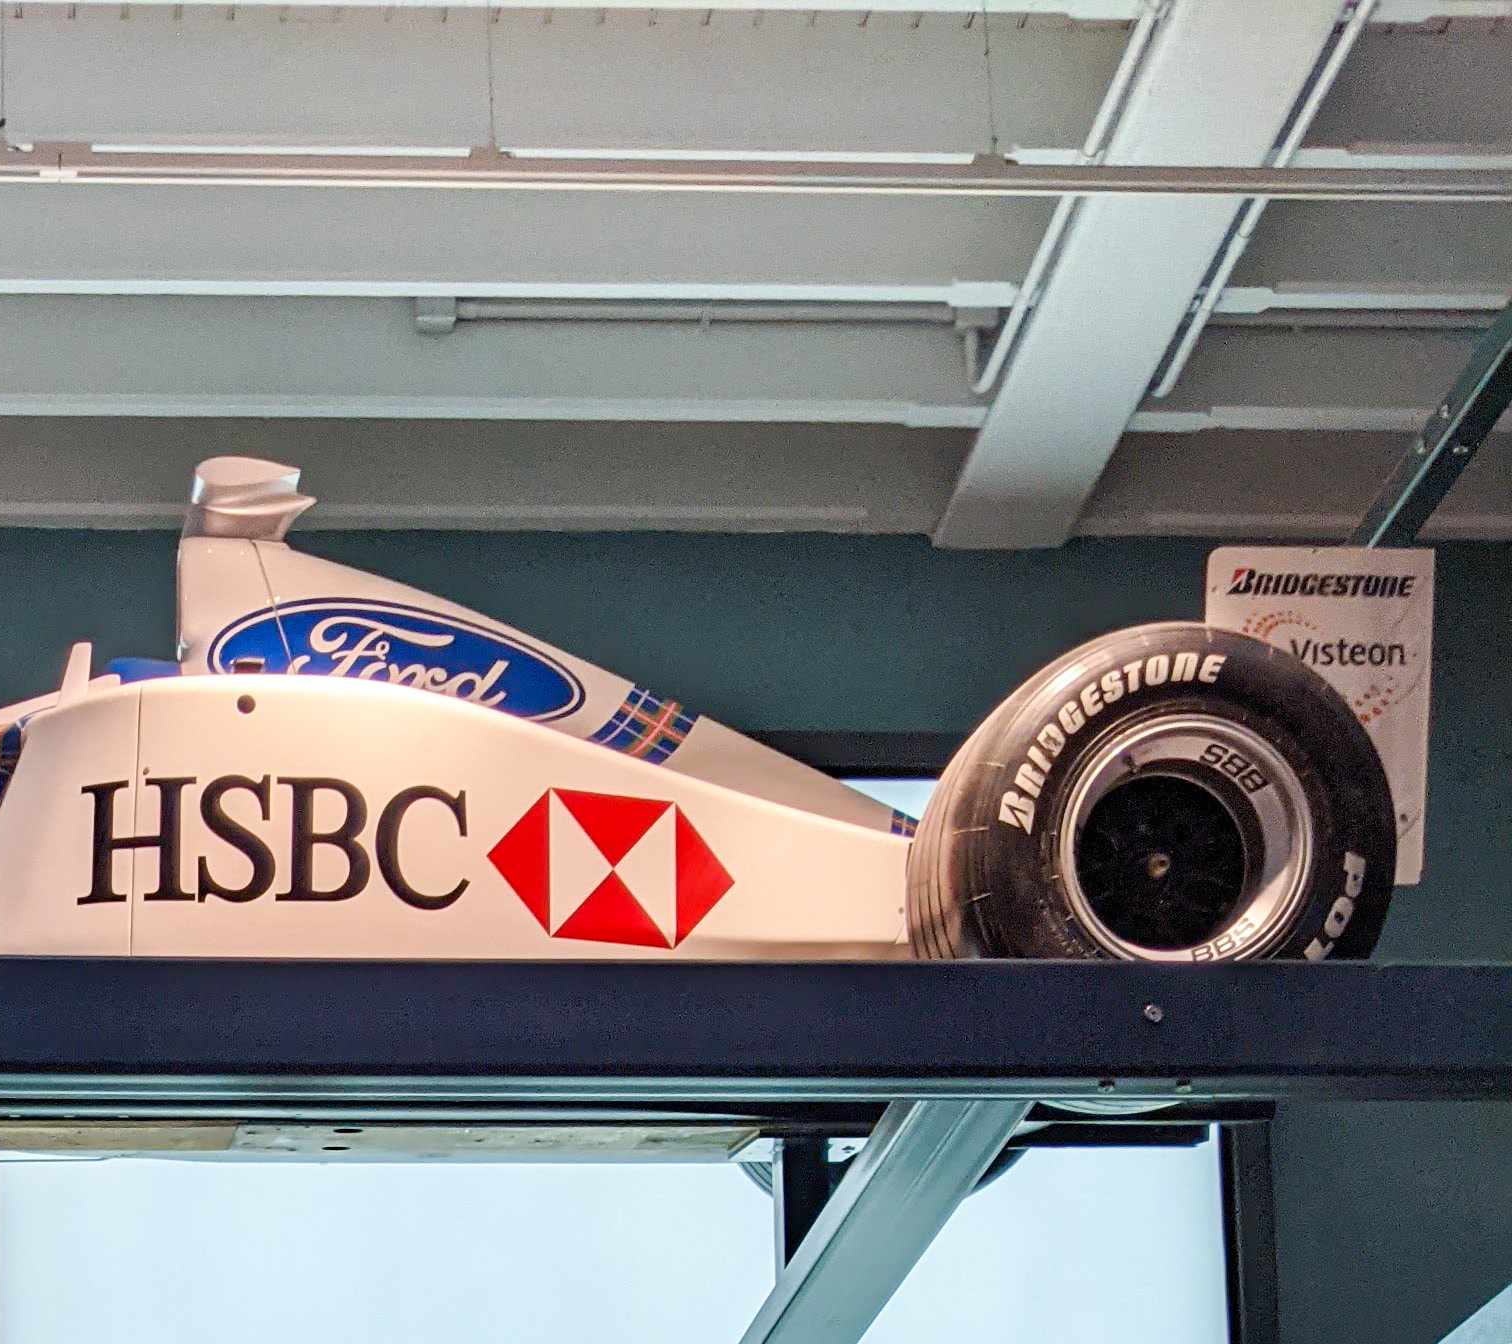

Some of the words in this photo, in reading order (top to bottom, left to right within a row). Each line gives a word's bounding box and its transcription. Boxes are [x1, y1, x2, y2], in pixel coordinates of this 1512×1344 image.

[1227, 567, 1416, 599] BRIDGESTONE
[1289, 637, 1405, 667] Visteon
[999, 651, 1228, 835] BRIDGESTONE
[1199, 743, 1267, 794] BBS
[76, 773, 472, 911] HSBC
